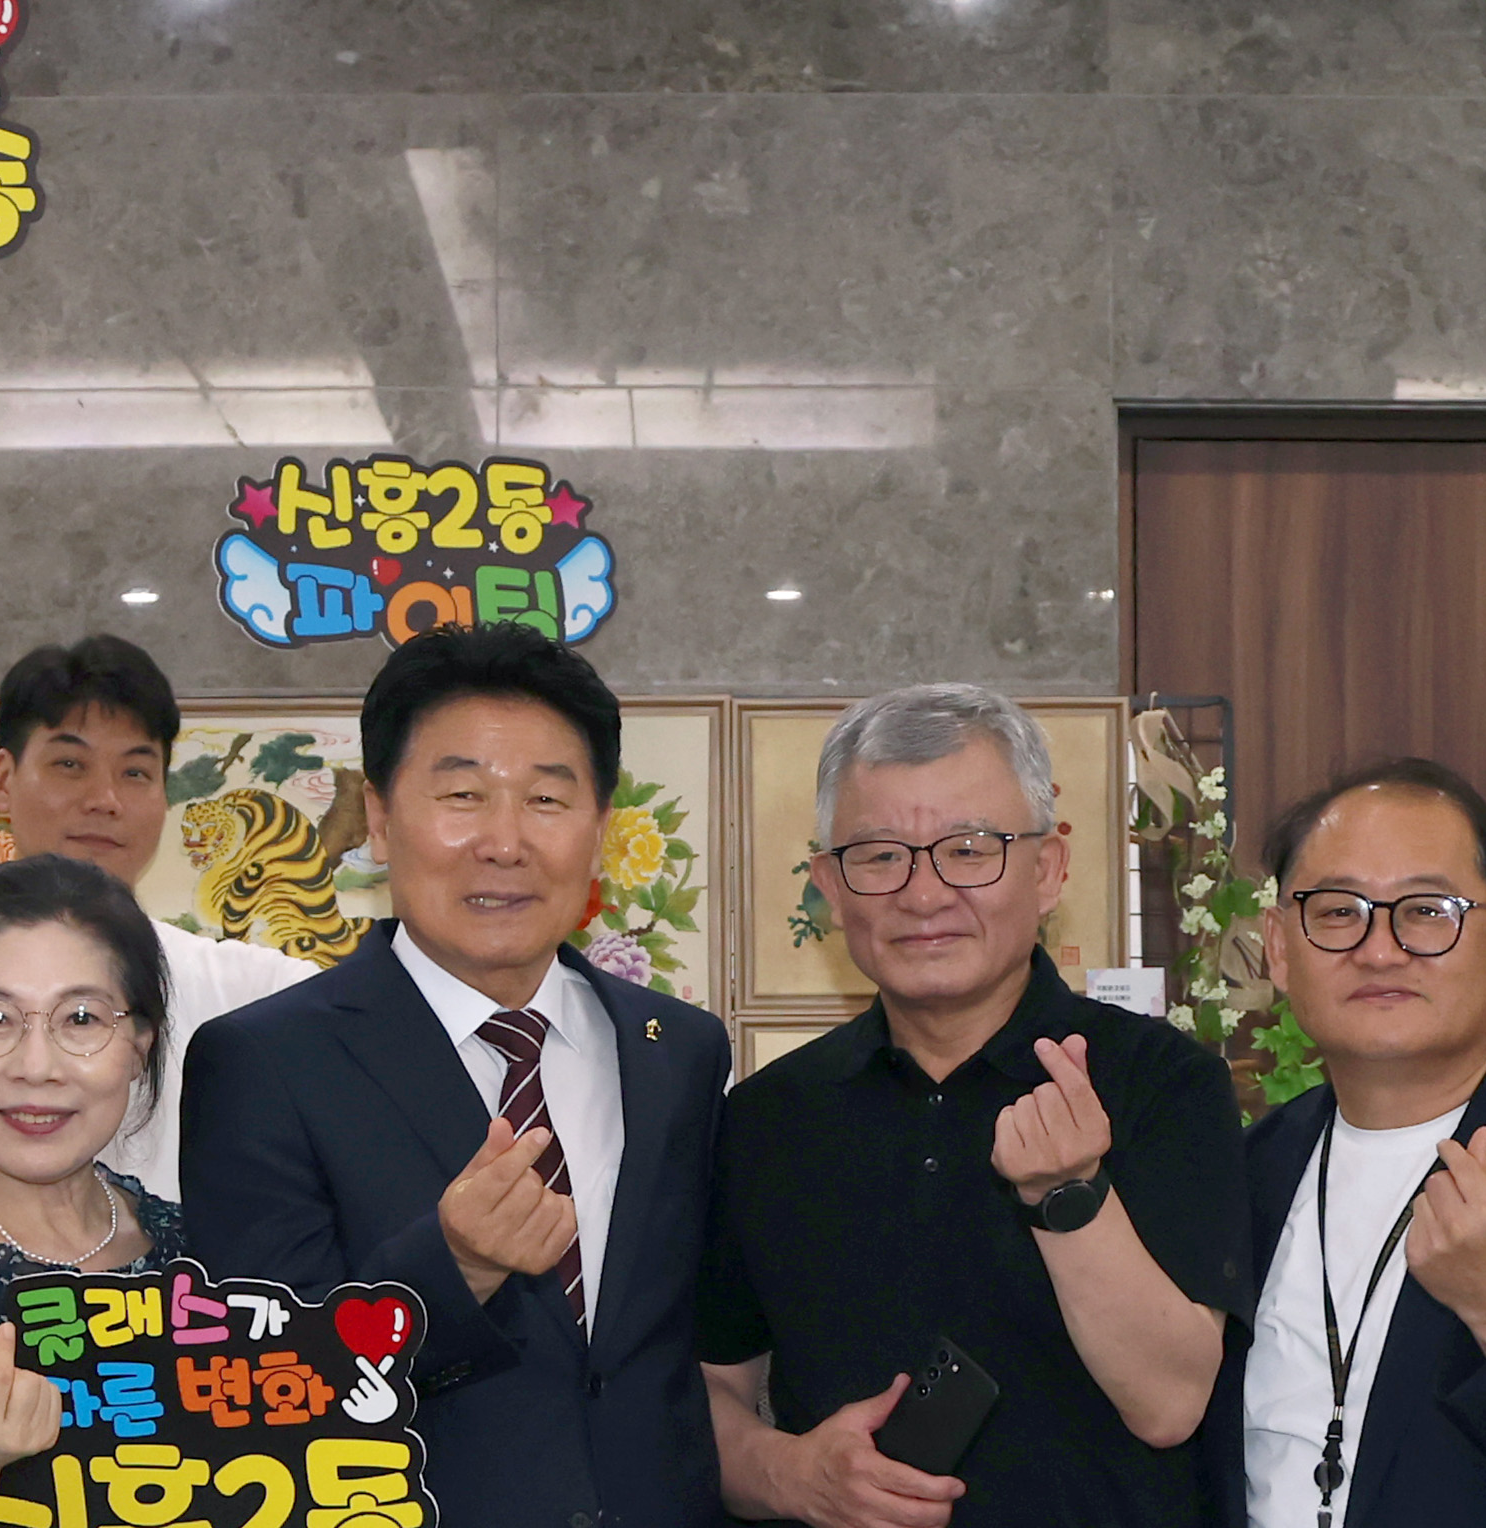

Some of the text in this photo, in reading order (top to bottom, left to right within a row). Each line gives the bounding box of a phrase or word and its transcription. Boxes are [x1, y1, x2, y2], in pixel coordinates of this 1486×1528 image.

[277, 460, 553, 554] 신흥2동
[285, 563, 559, 651] 파이팅
[16, 1274, 291, 1366] 클래스가
[176, 1351, 335, 1428] 변화
